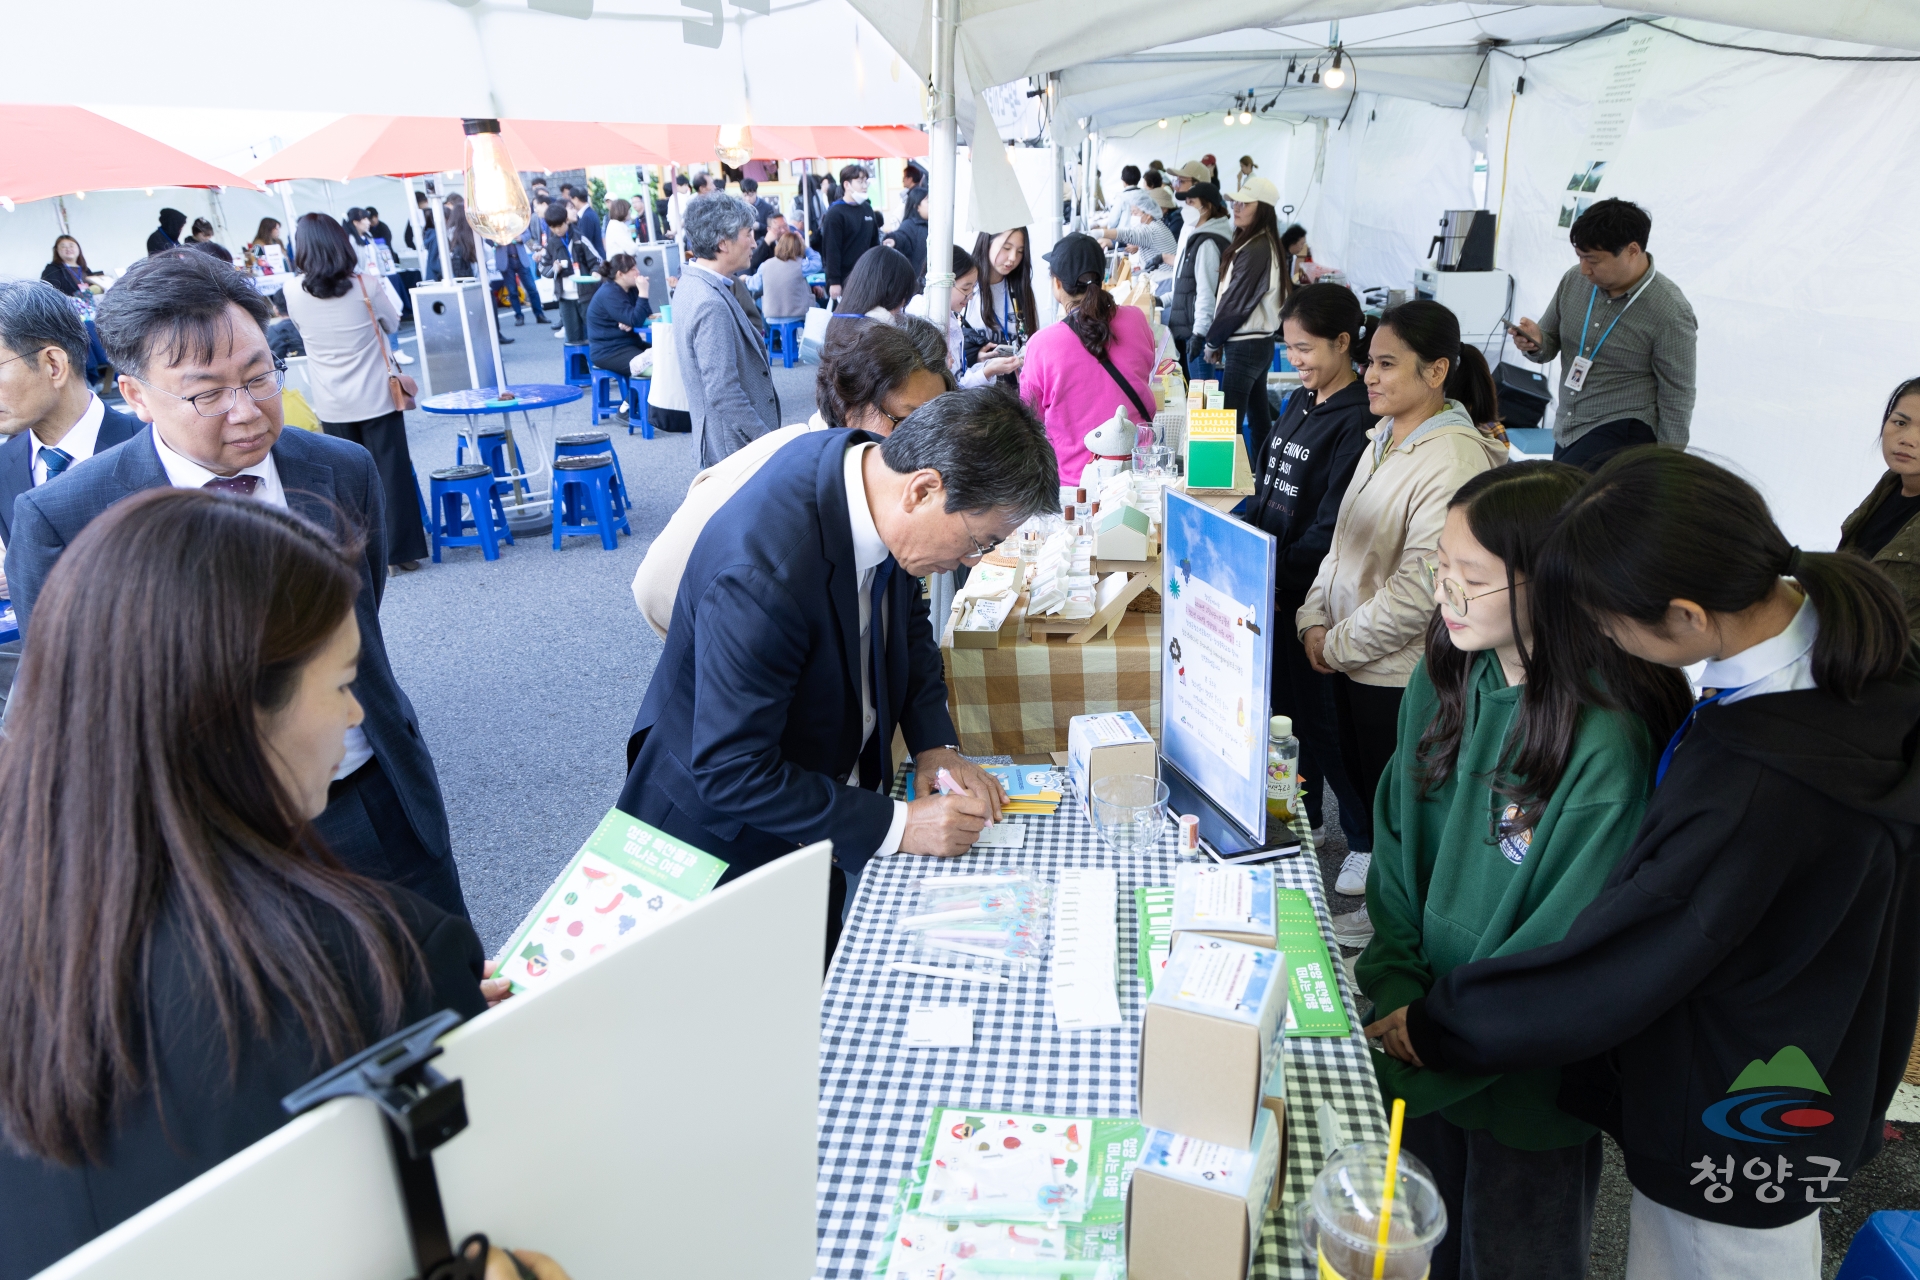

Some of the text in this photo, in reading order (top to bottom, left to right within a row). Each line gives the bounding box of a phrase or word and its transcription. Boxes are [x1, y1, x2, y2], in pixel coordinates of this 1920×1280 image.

[623, 840, 660, 867] 떠나는
[658, 858, 686, 878] 여행
[626, 825, 698, 868] 청양 특산물과
[1296, 967, 1311, 992] 떠나는
[1304, 994, 1319, 1009] 여행
[1308, 963, 1334, 1012] 청양 특산물과
[1122, 1137, 1138, 1158] 청양
[1102, 1143, 1121, 1198] 떠나는 여행
